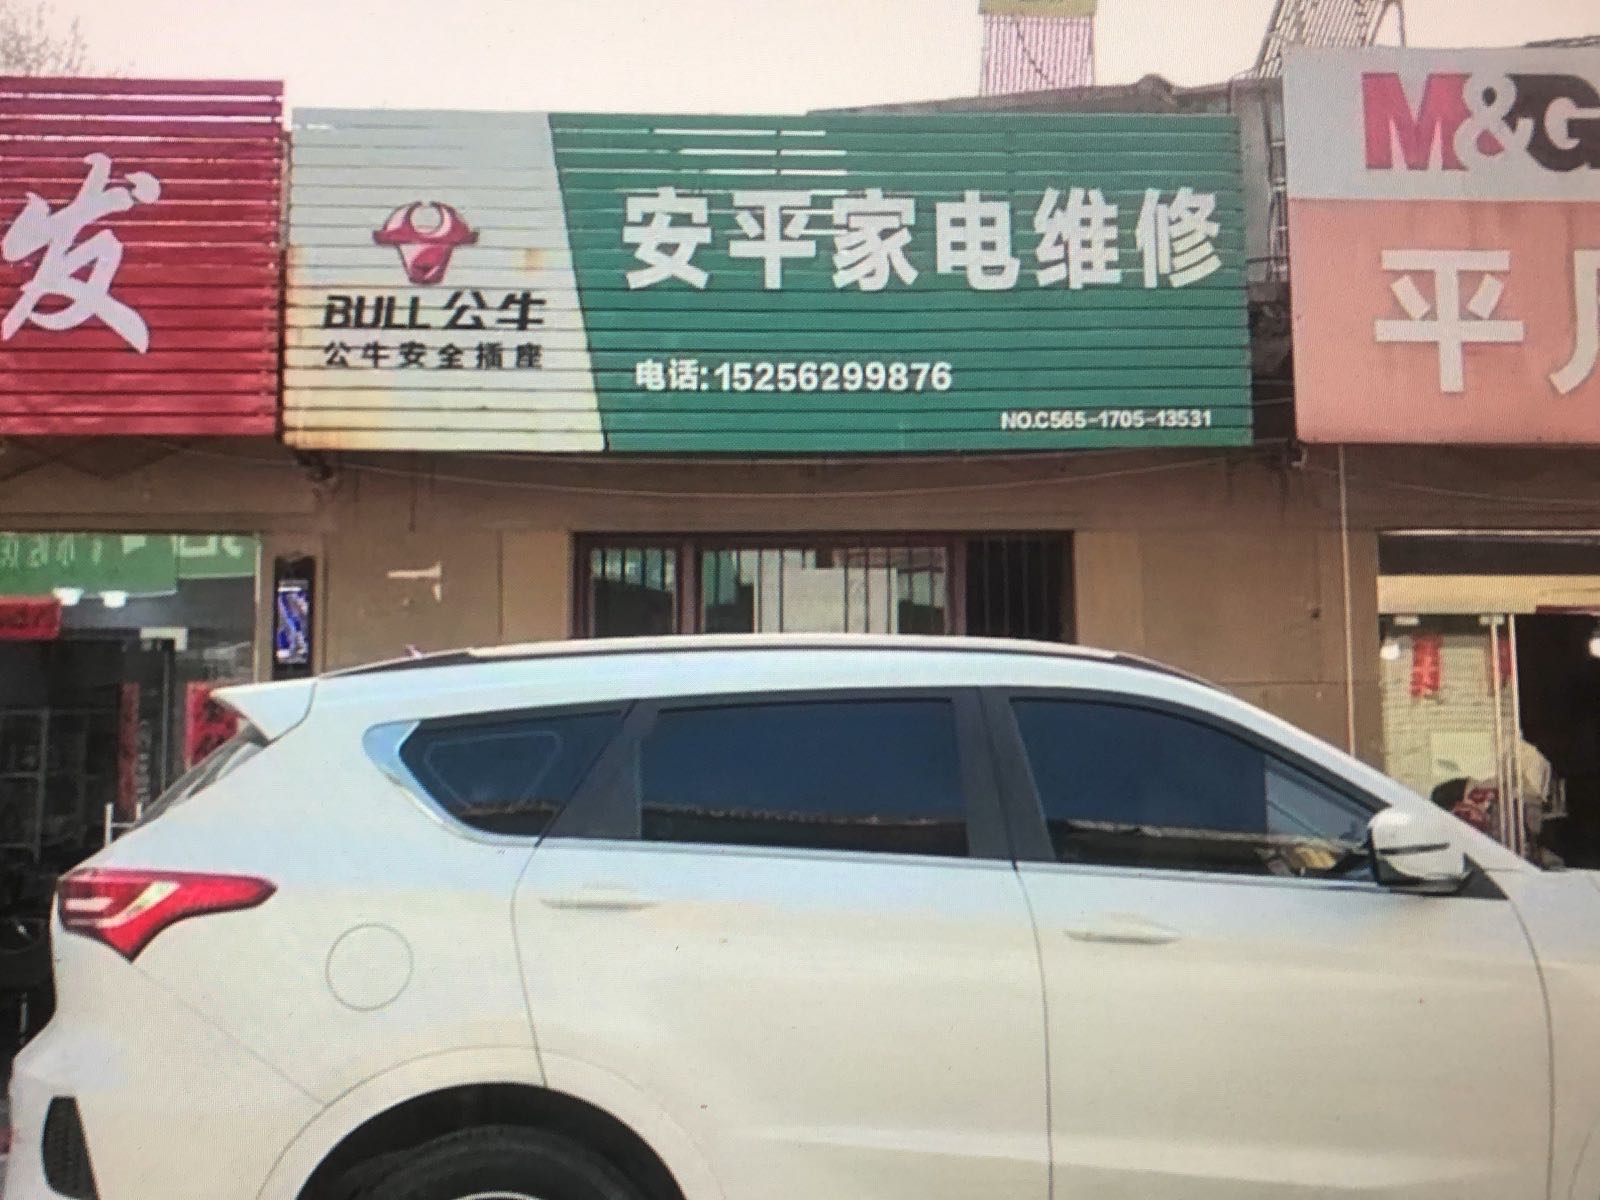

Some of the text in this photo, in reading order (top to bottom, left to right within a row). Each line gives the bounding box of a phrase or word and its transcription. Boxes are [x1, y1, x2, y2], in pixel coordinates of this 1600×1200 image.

[1361, 72, 1600, 172] M&G
[2, 153, 162, 354] 发
[621, 187, 1223, 291] 安平家电维修
[324, 290, 546, 330] BULL 公牛
[324, 341, 543, 370] 公牛安全插座
